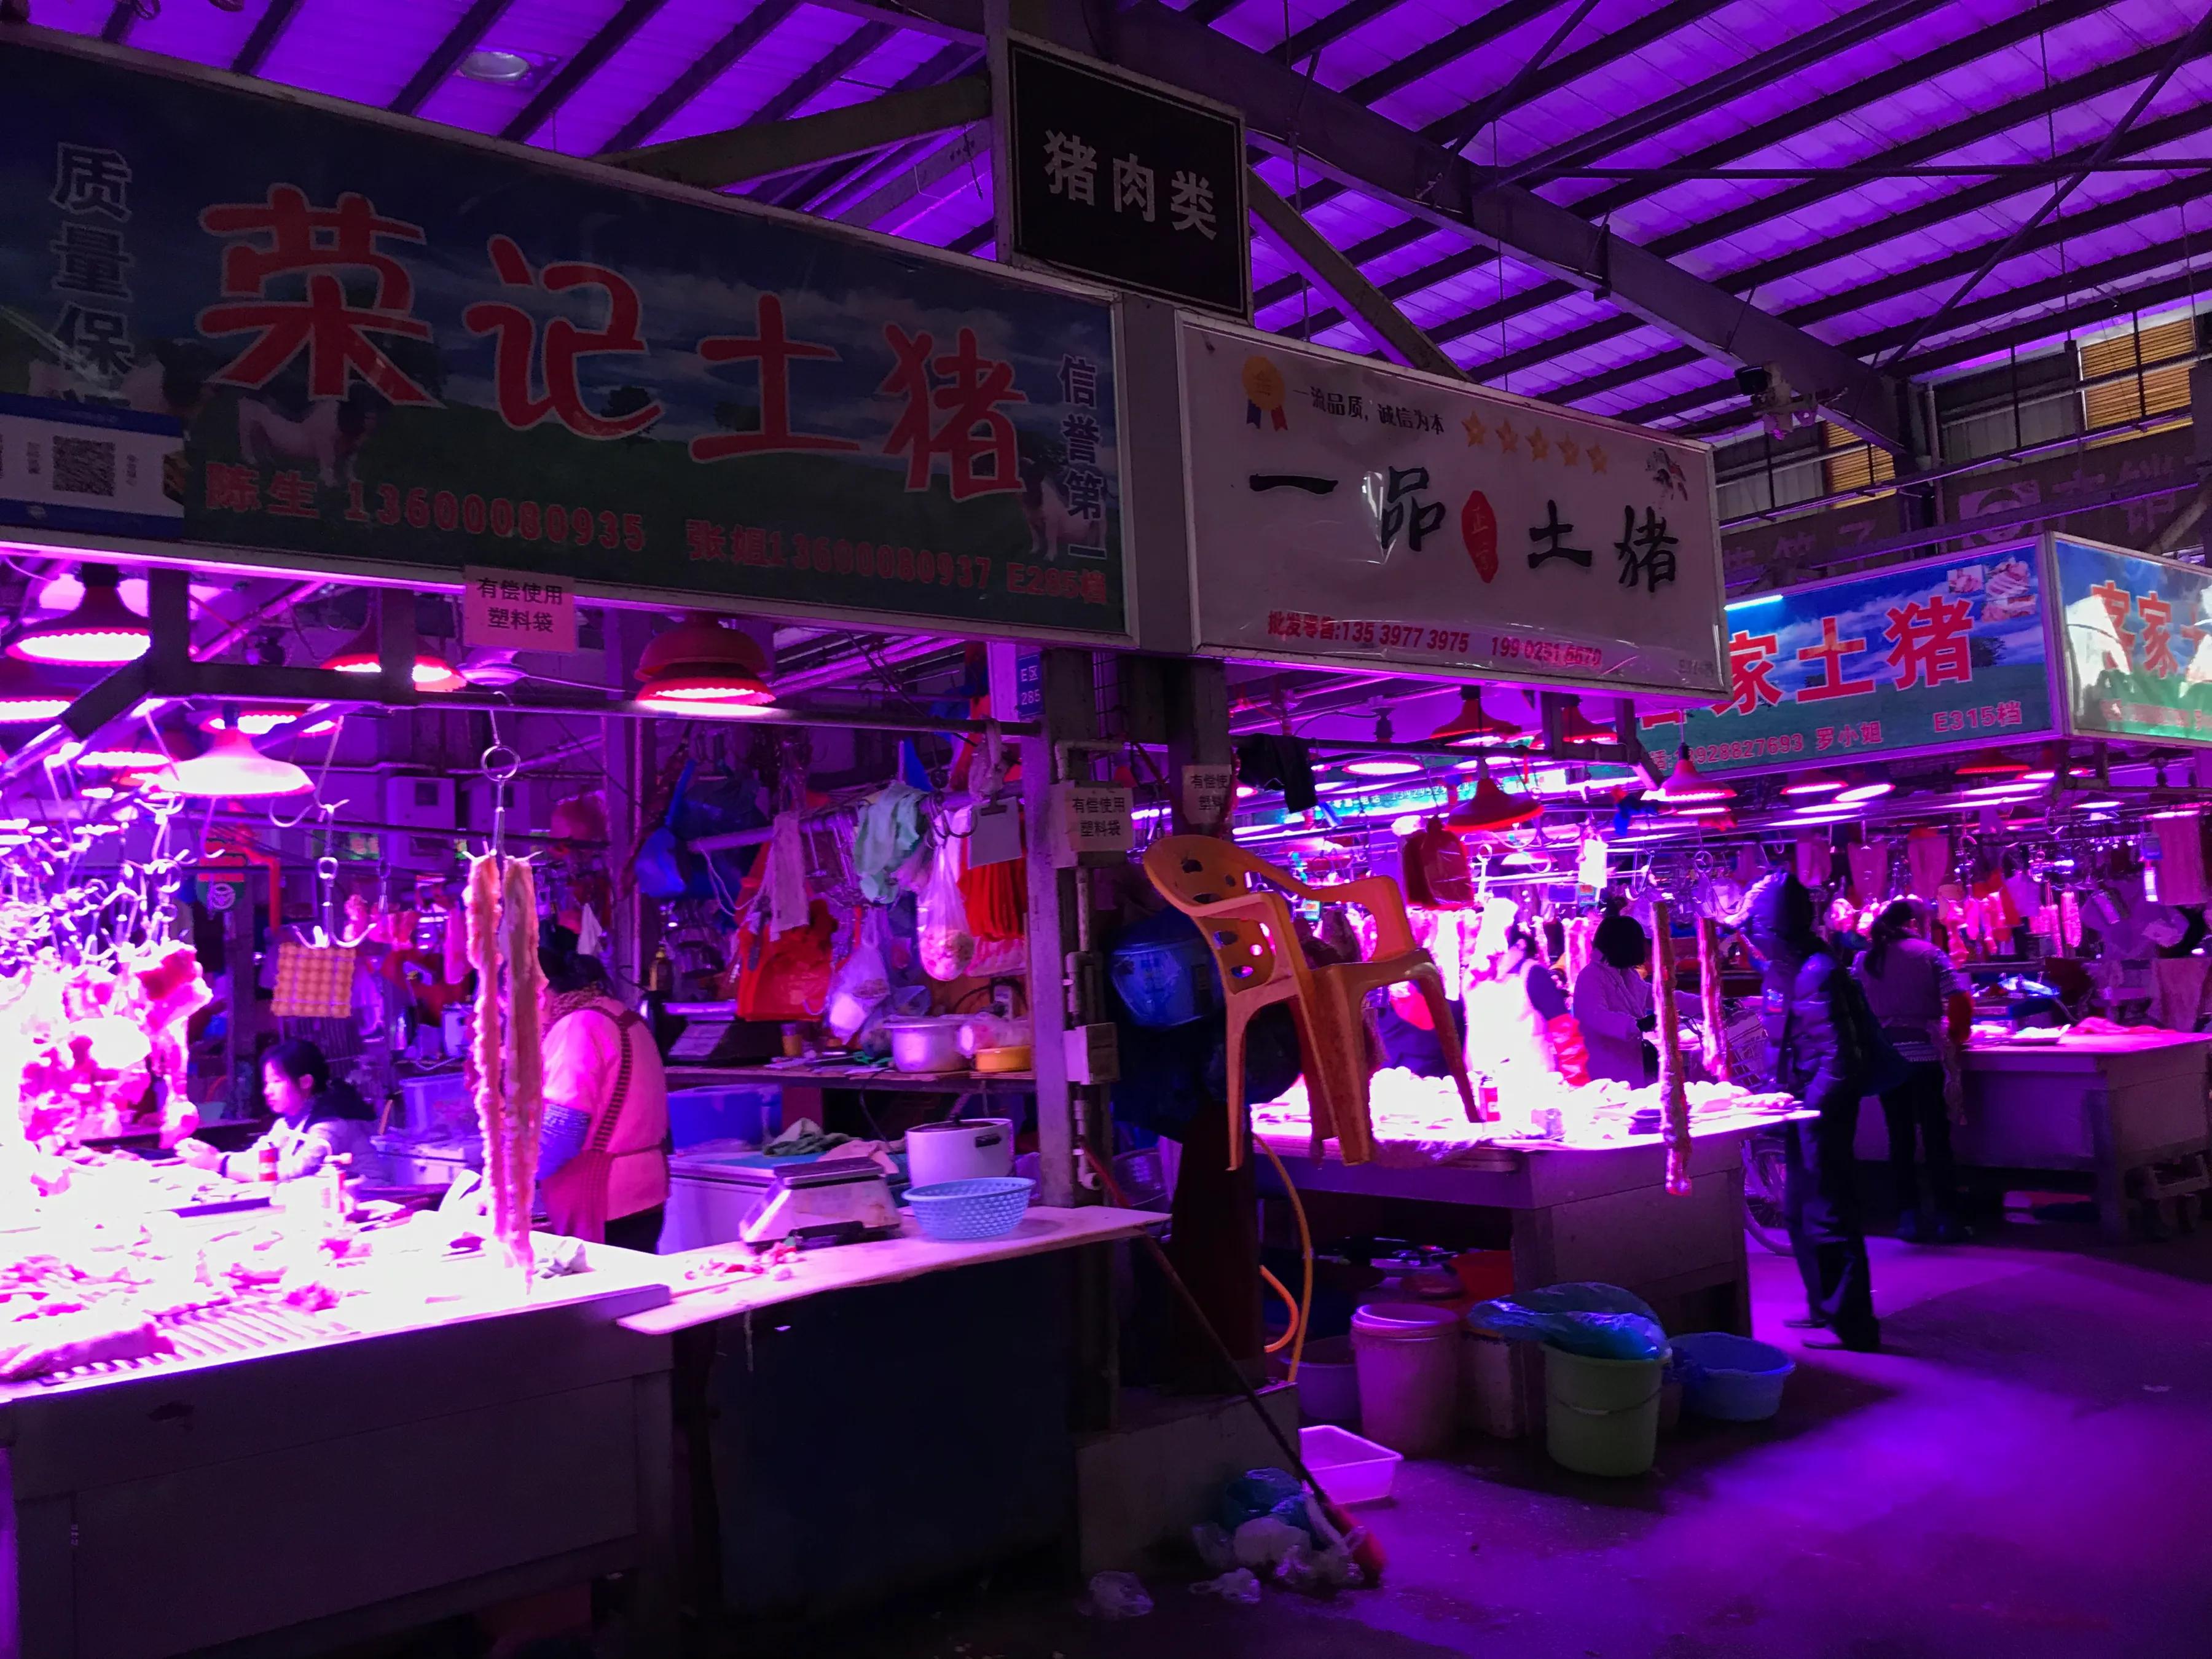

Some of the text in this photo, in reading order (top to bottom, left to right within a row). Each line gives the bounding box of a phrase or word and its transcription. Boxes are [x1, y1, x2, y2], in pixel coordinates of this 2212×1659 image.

[1043, 128, 1217, 240] 猪肉类
[49, 141, 133, 407] 质量保
[195, 183, 1029, 503] 荣记土猪
[1056, 353, 1108, 561] 信誉第一
[204, 461, 320, 520] 陈生
[343, 479, 646, 552] 13600080935
[1528, 499, 1679, 594] 土猪
[477, 578, 562, 605] 有偿使用
[488, 607, 554, 633] 塑料袋
[1379, 625, 1424, 648] 3977
[1427, 629, 1470, 653] 3975
[1021, 665, 1039, 682] E区
[1021, 688, 1041, 705] 285
[1816, 721, 1883, 751] 罗小姐
[1933, 700, 2022, 733] E315档
[1072, 797, 1125, 813] 有偿使用
